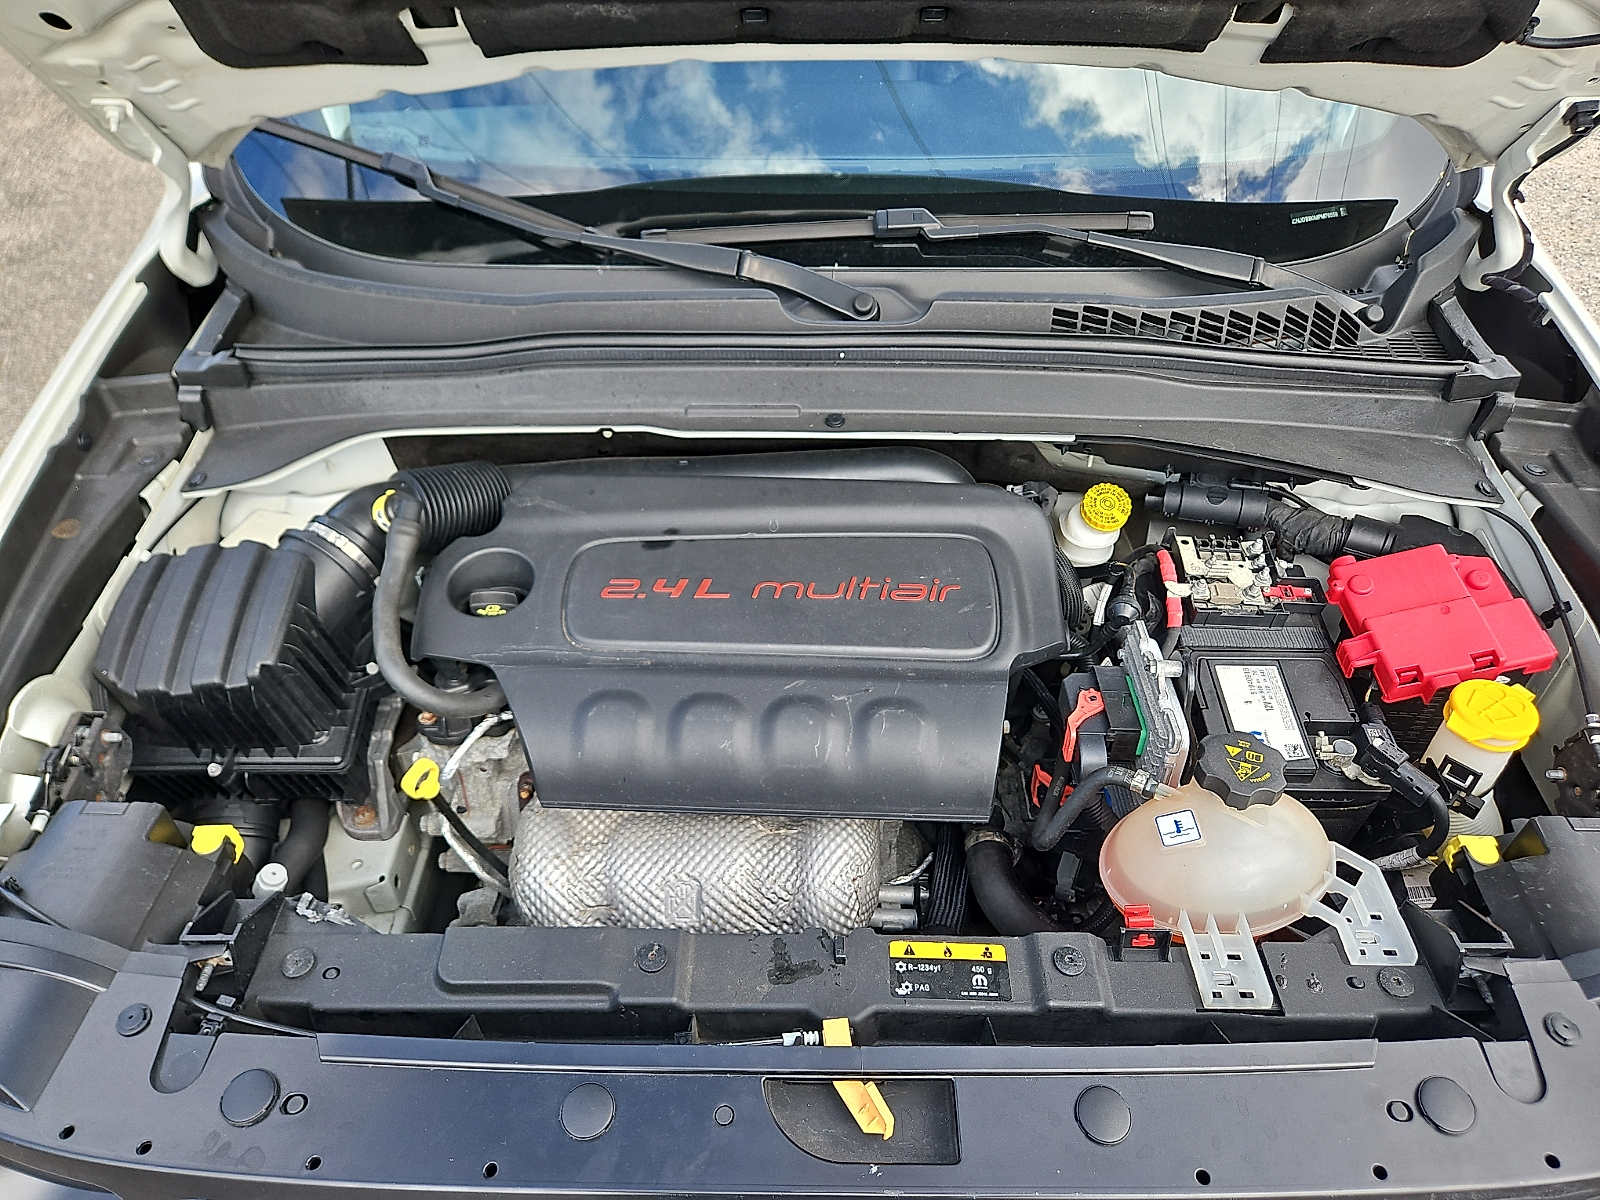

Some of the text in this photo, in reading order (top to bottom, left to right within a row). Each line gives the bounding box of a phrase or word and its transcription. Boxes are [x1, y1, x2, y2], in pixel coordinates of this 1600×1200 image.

[600, 576, 962, 602] 2.4L multiair
[971, 965, 985, 973] 450
[914, 983, 930, 992] PAG
